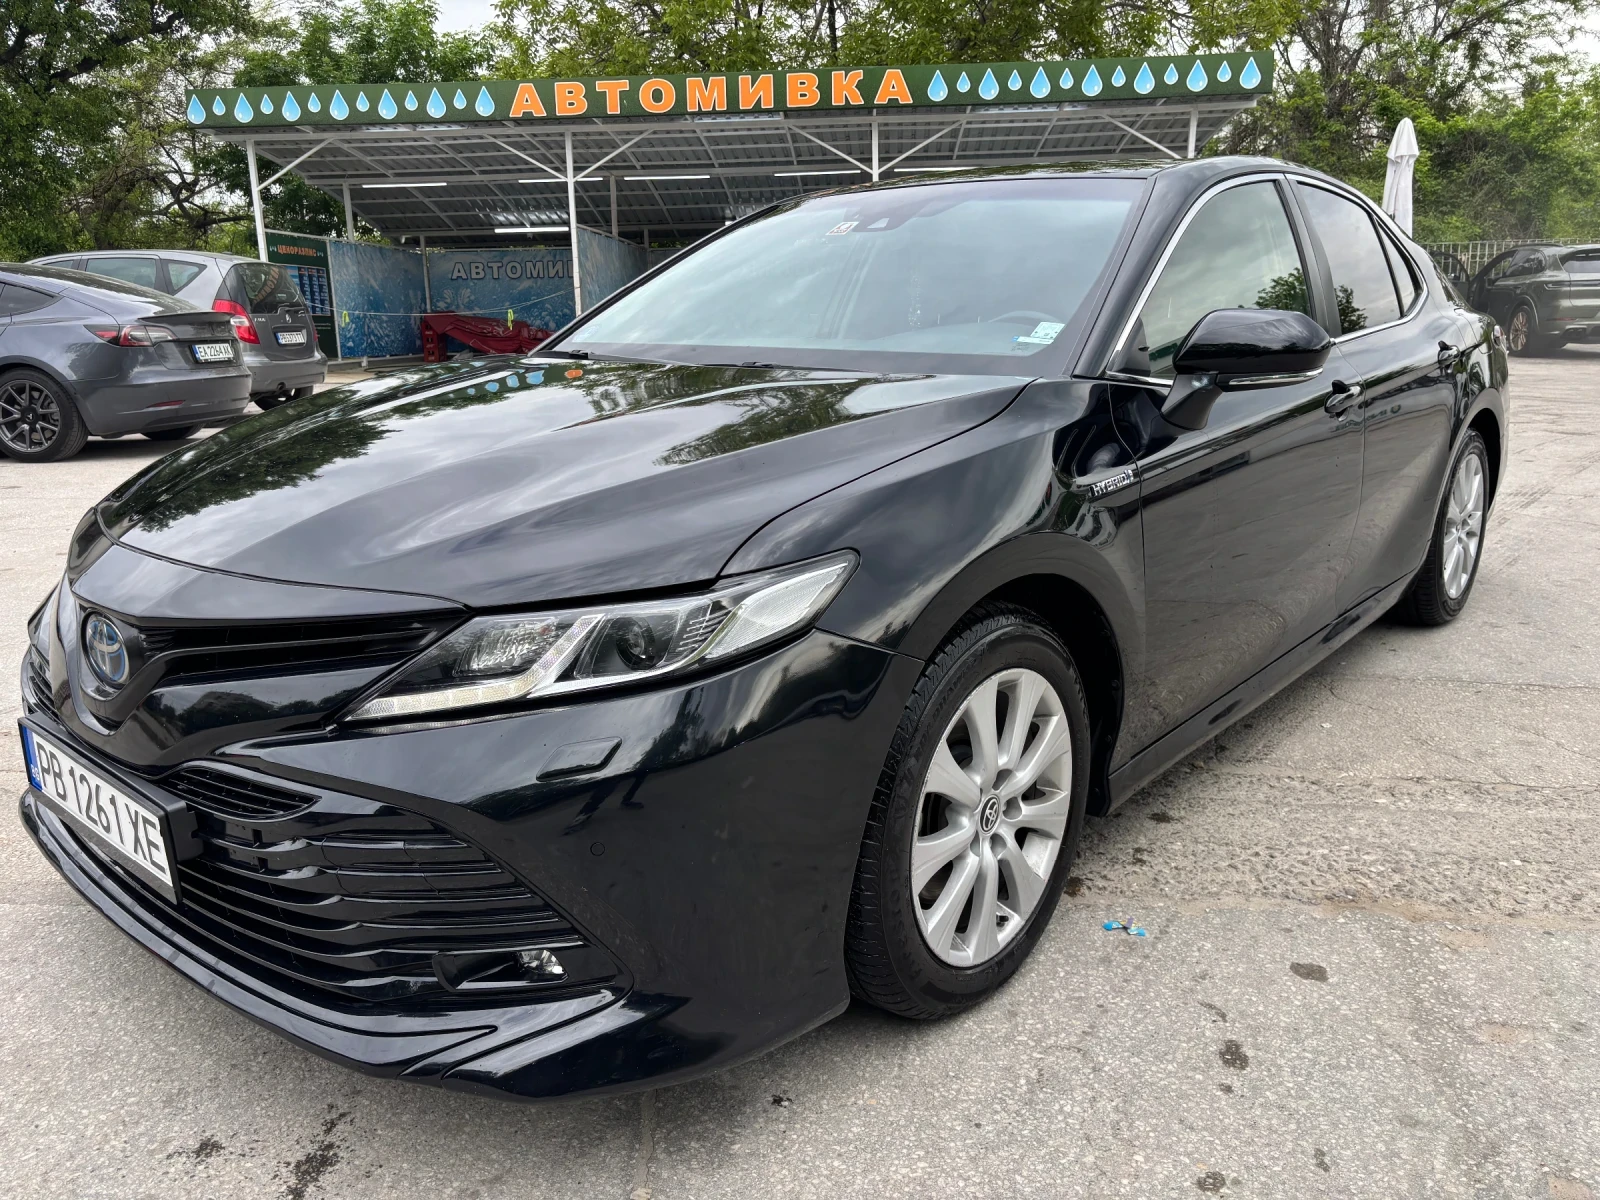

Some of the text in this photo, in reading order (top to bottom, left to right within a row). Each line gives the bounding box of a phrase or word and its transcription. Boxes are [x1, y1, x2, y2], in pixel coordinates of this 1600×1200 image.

[509, 69, 913, 117] АВТОМИВКА
[1091, 470, 1132, 496] HYBRID
[36, 741, 167, 876] PB 1261 XE
